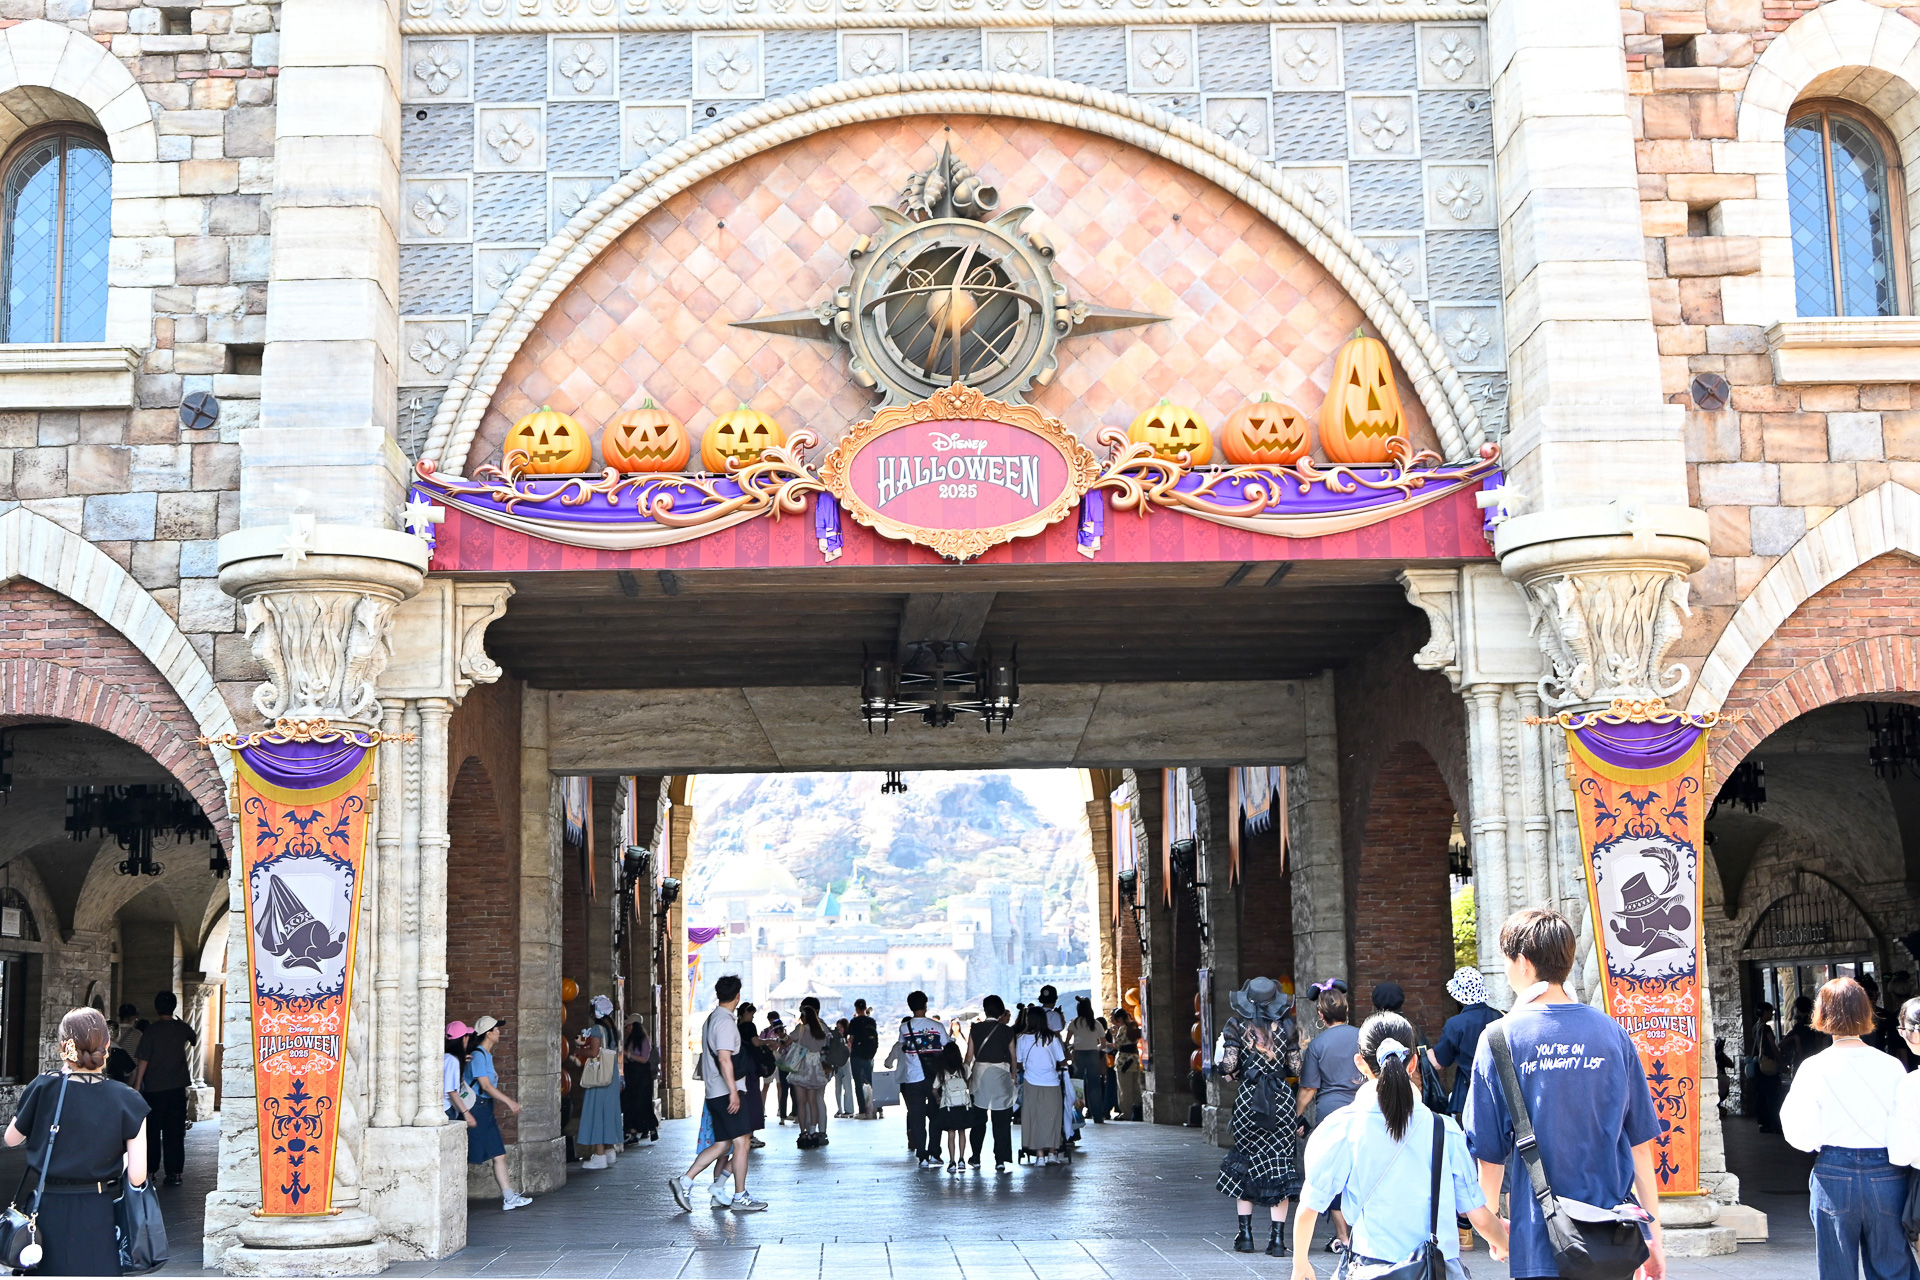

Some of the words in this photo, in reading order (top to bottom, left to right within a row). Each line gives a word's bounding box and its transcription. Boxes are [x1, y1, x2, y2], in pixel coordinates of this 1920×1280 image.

[928, 432, 988, 456] Disney
[876, 455, 1041, 509] HALLOWEEN
[938, 483, 978, 499] 2025
[1640, 1003, 1670, 1015] Disney
[286, 1022, 315, 1035] Disney
[1615, 1015, 1697, 1042] HALLOWEEN
[1646, 1030, 1667, 1039] 2025
[259, 1034, 340, 1063] HALLOWEEN
[289, 1049, 309, 1058] 2025
[1535, 1042, 1570, 1058] YOU'RE
[1571, 1043, 1585, 1056] ON
[1519, 1060, 1538, 1075] THE
[1539, 1056, 1582, 1071] NAUGHTY
[1583, 1056, 1606, 1070] LIST
